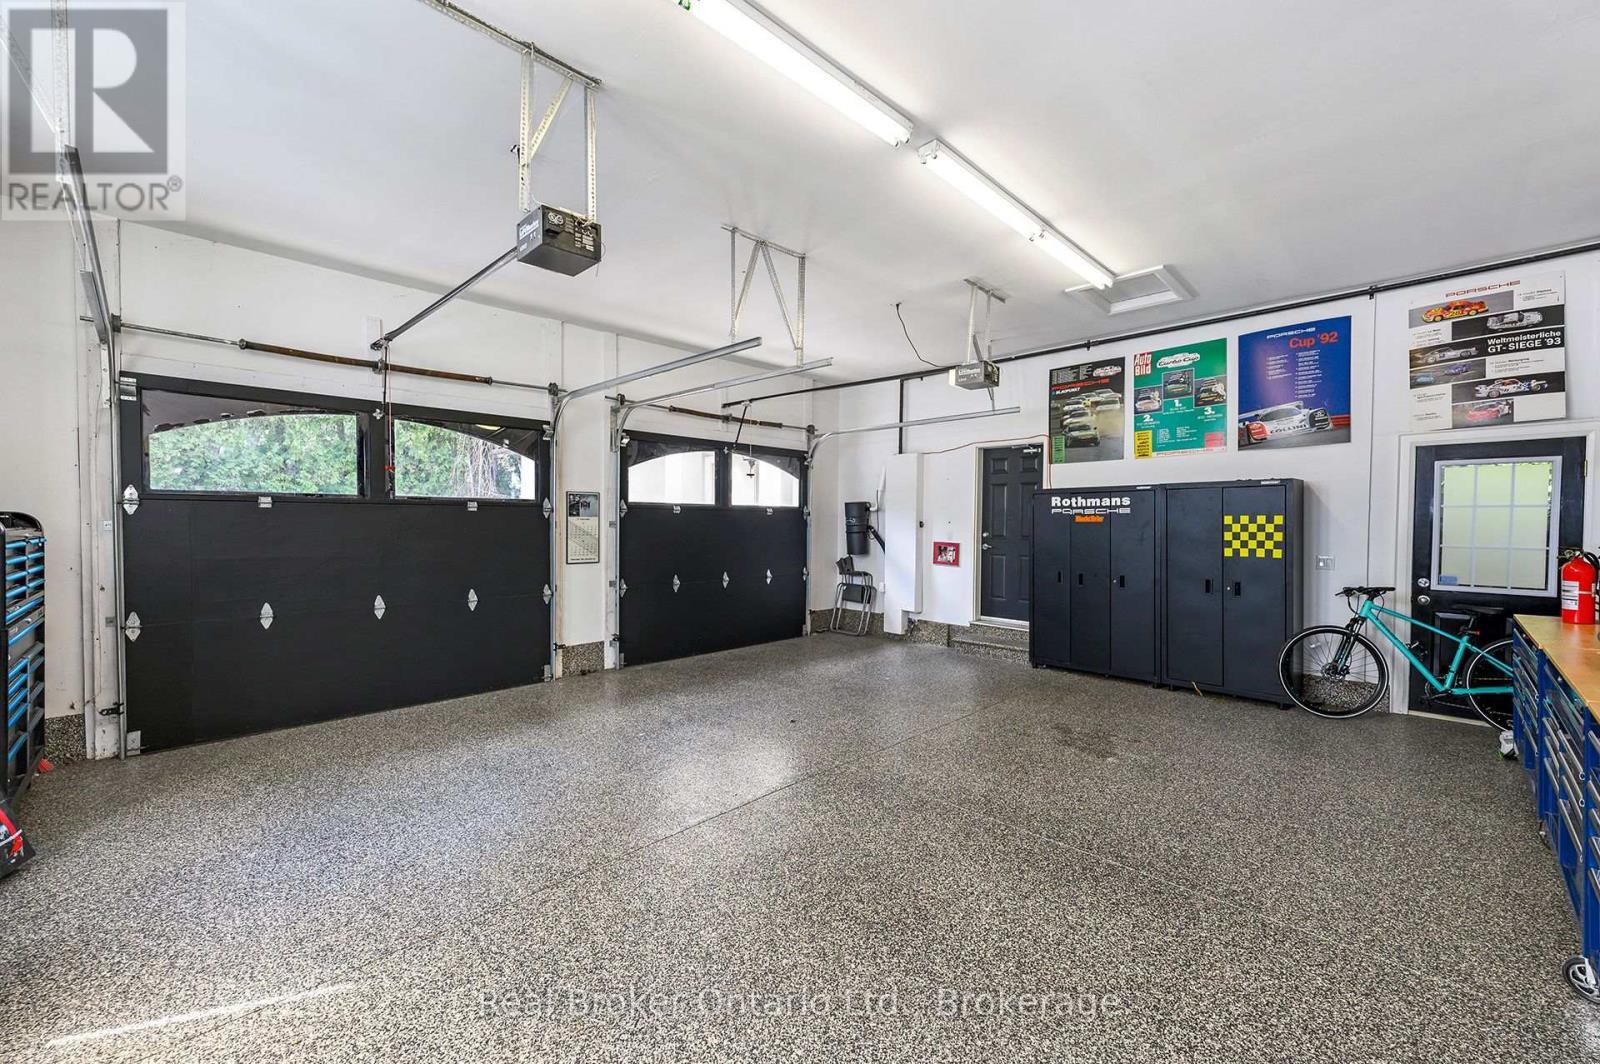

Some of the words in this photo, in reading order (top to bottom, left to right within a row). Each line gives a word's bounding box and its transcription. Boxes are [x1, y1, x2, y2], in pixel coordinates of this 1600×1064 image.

[1445, 280, 1521, 298] PORSCHE
[1266, 327, 1316, 339] PORSCHE
[1487, 331, 1561, 345] Weltmeisterliche
[1288, 337, 1315, 349] Cup
[1317, 331, 1339, 344] '92
[1508, 339, 1542, 351] SIEGE
[1544, 337, 1561, 346] '93
[1134, 352, 1152, 366] Auto
[1134, 364, 1152, 377] Bild
[1173, 399, 1182, 407] 1.
[1203, 406, 1215, 415] 3.
[1142, 414, 1154, 422] 2.
[1051, 496, 1131, 508] Rothmans
[1051, 507, 1131, 515] PORSCHE
